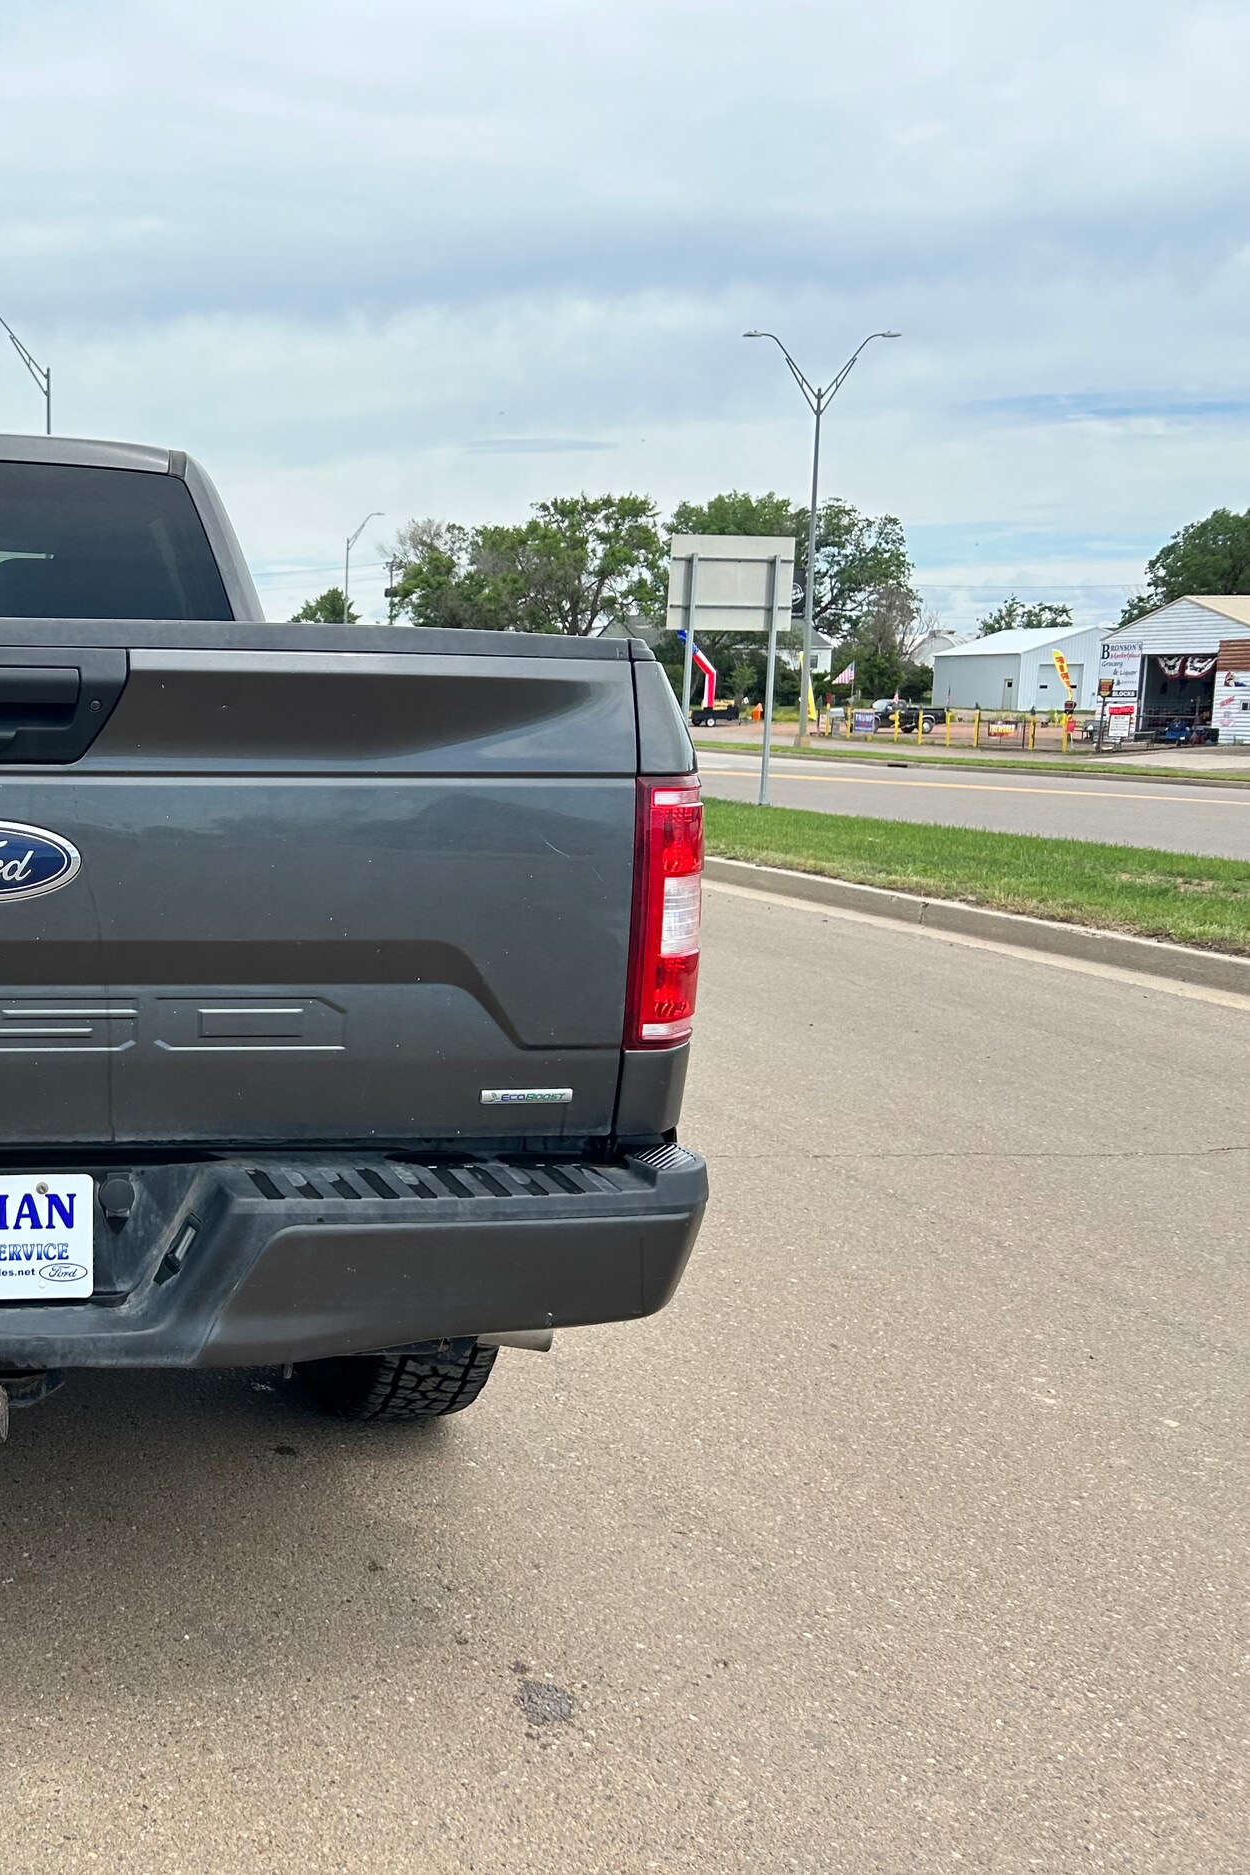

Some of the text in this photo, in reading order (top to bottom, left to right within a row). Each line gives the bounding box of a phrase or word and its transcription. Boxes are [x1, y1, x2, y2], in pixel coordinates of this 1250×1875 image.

[1100, 643, 1142, 660] BRONSON'S
[1101, 660, 1124, 669] Grocery
[855, 713, 874, 722] TRUMP
[48, 1265, 78, 1279] Ford
